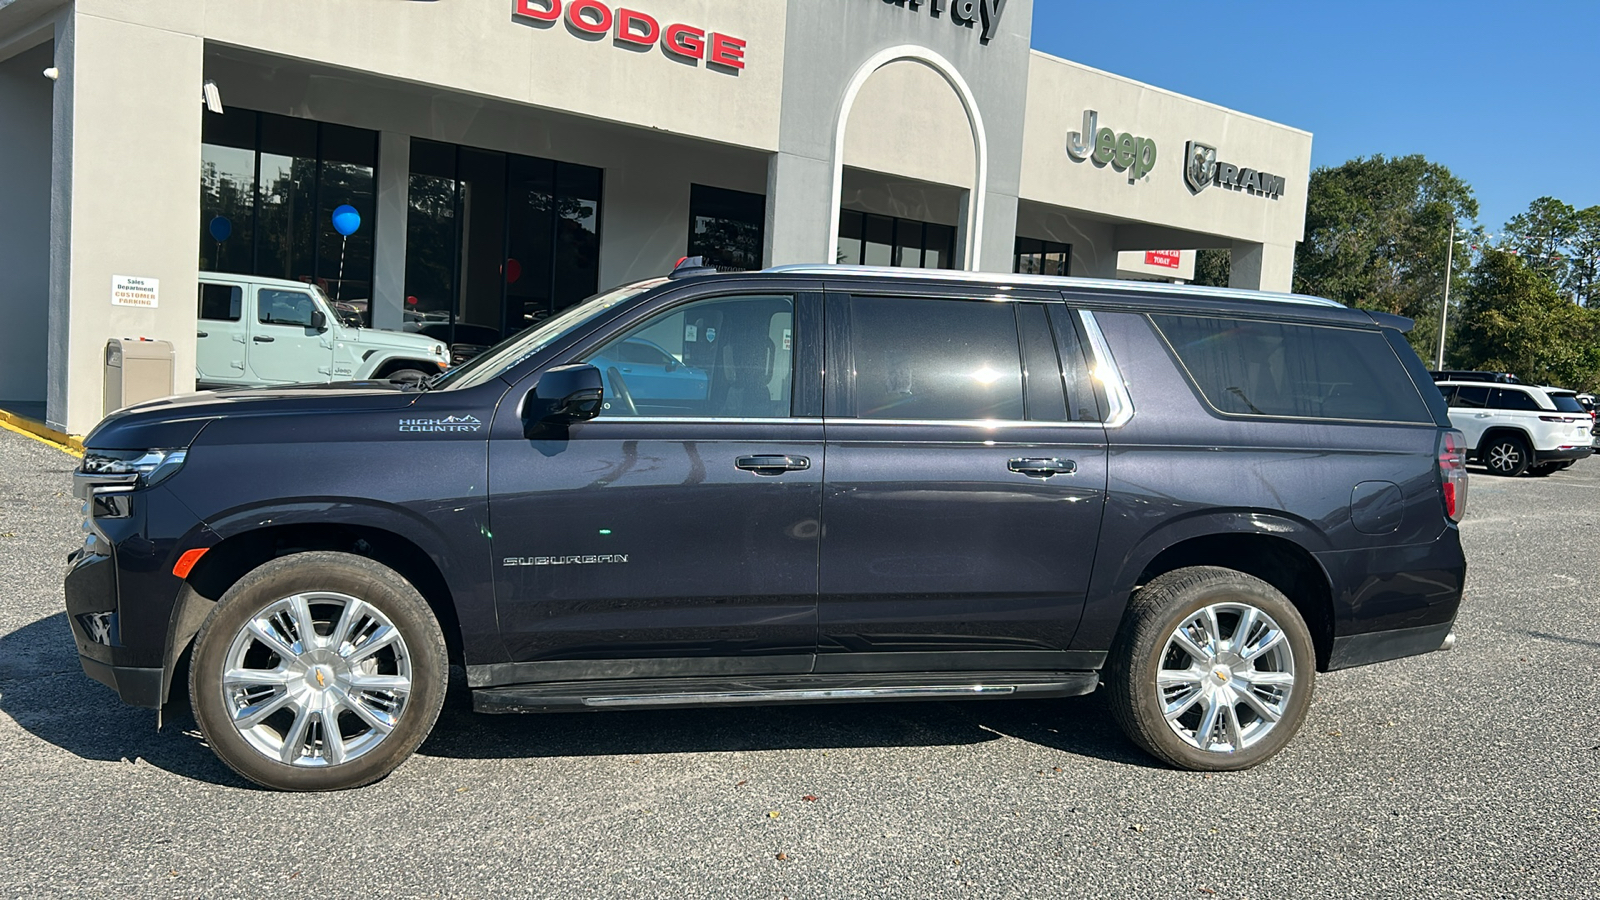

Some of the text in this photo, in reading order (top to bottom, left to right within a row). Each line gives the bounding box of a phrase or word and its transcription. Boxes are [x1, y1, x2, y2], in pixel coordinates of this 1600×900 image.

[1066, 110, 1157, 183] Jeep
[1214, 161, 1286, 199] RAM
[1153, 256, 1170, 265] TODAY
[117, 284, 154, 292] Department
[503, 554, 629, 567] SUBURBAN
